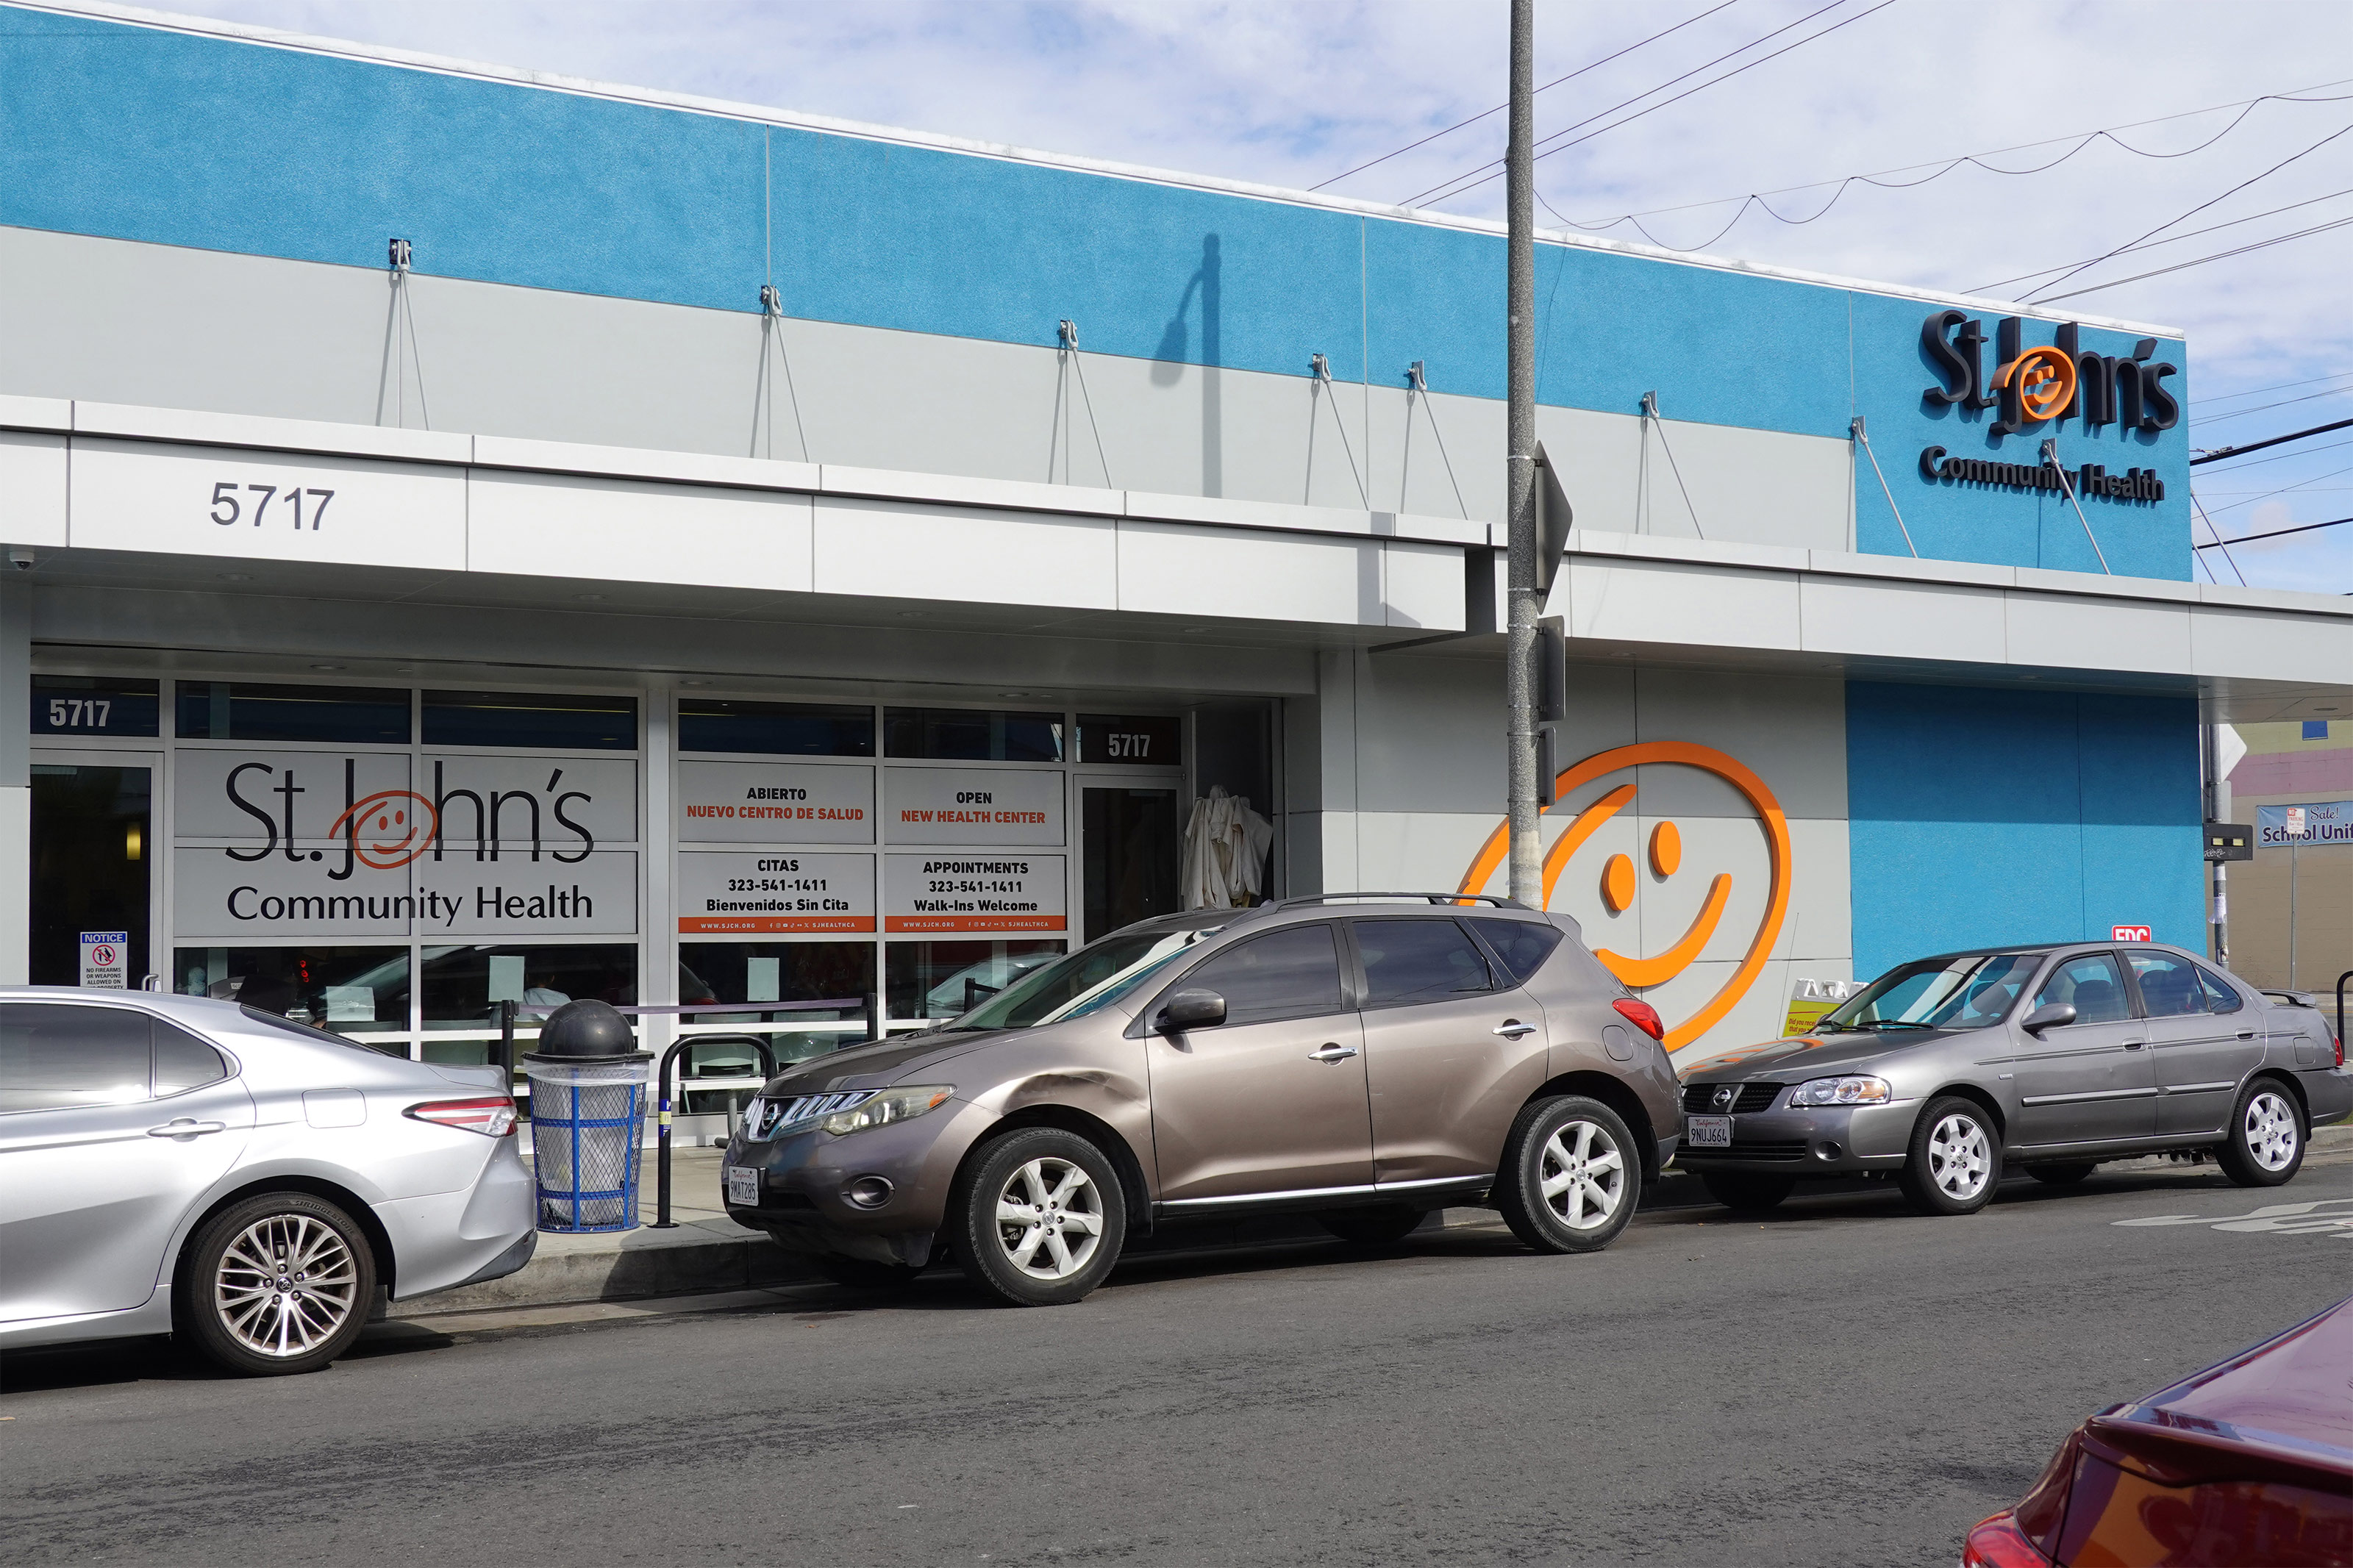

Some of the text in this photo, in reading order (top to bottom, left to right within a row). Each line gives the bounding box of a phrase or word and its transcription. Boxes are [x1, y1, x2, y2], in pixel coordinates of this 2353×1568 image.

[2080, 464, 2164, 501] Health
[211, 482, 335, 530] 5717
[50, 699, 110, 726] 5717
[1108, 734, 1150, 756] 5717
[746, 787, 807, 800] ABIERTO
[956, 792, 992, 803] OPEN
[687, 805, 863, 820] NUEVO CENTRO DE SALUD
[901, 810, 1046, 823] NEW HEALTH CENTER
[2310, 806, 2338, 820] Sale!
[757, 859, 799, 872] CITAS
[923, 862, 1029, 874] APPOINTMENTS
[728, 879, 826, 891] 323-541-1411
[929, 881, 1022, 892] 323-541-1411
[227, 885, 593, 926] Community Health
[706, 899, 849, 911] Bienvenidos Sin Cita
[913, 900, 1038, 912] Walk-Ins Welcome
[85, 934, 124, 942] NOTICE
[1691, 1128, 1727, 1142] 9NUJ664
